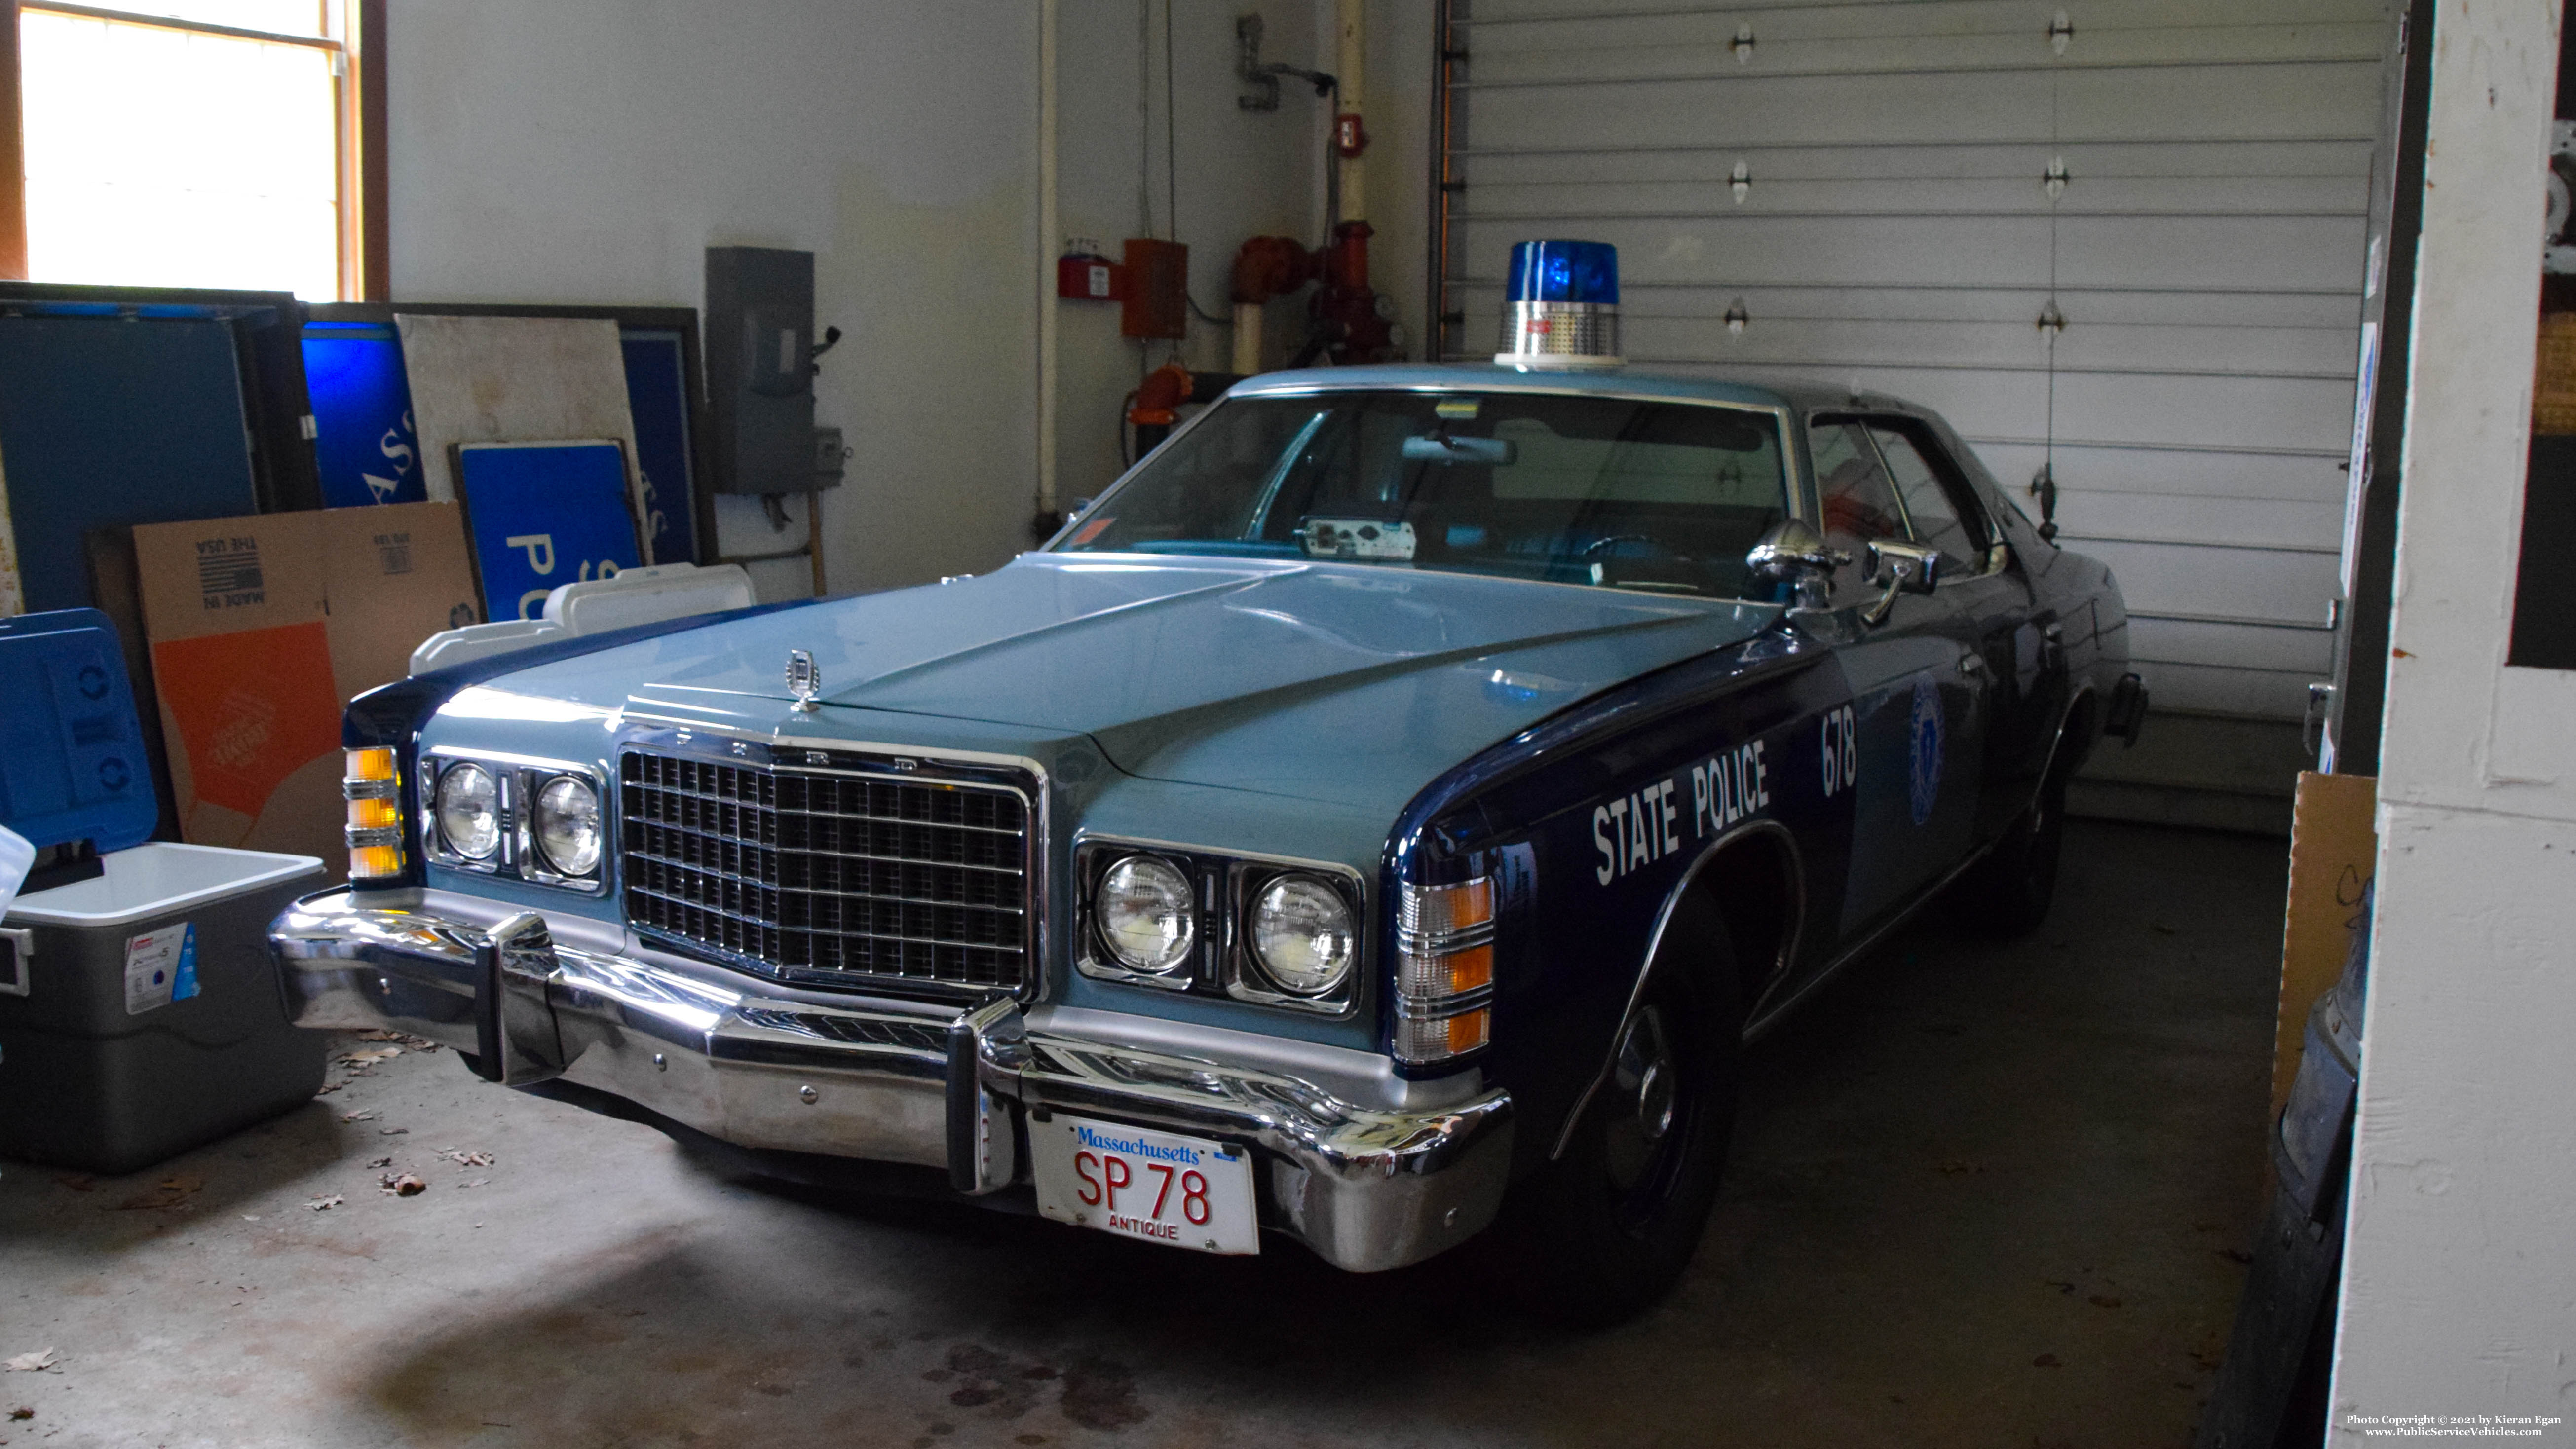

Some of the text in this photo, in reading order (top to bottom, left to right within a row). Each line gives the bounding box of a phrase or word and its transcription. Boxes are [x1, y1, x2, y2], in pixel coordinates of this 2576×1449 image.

[225, 593, 265, 607] MADE
[1821, 705, 1856, 798] 678
[1593, 739, 1769, 886] STATE POLICE
[1078, 1127, 1200, 1166] Massachusetts
[1075, 1151, 1209, 1225] SP 78
[1109, 1214, 1177, 1240] ANTIQUE
